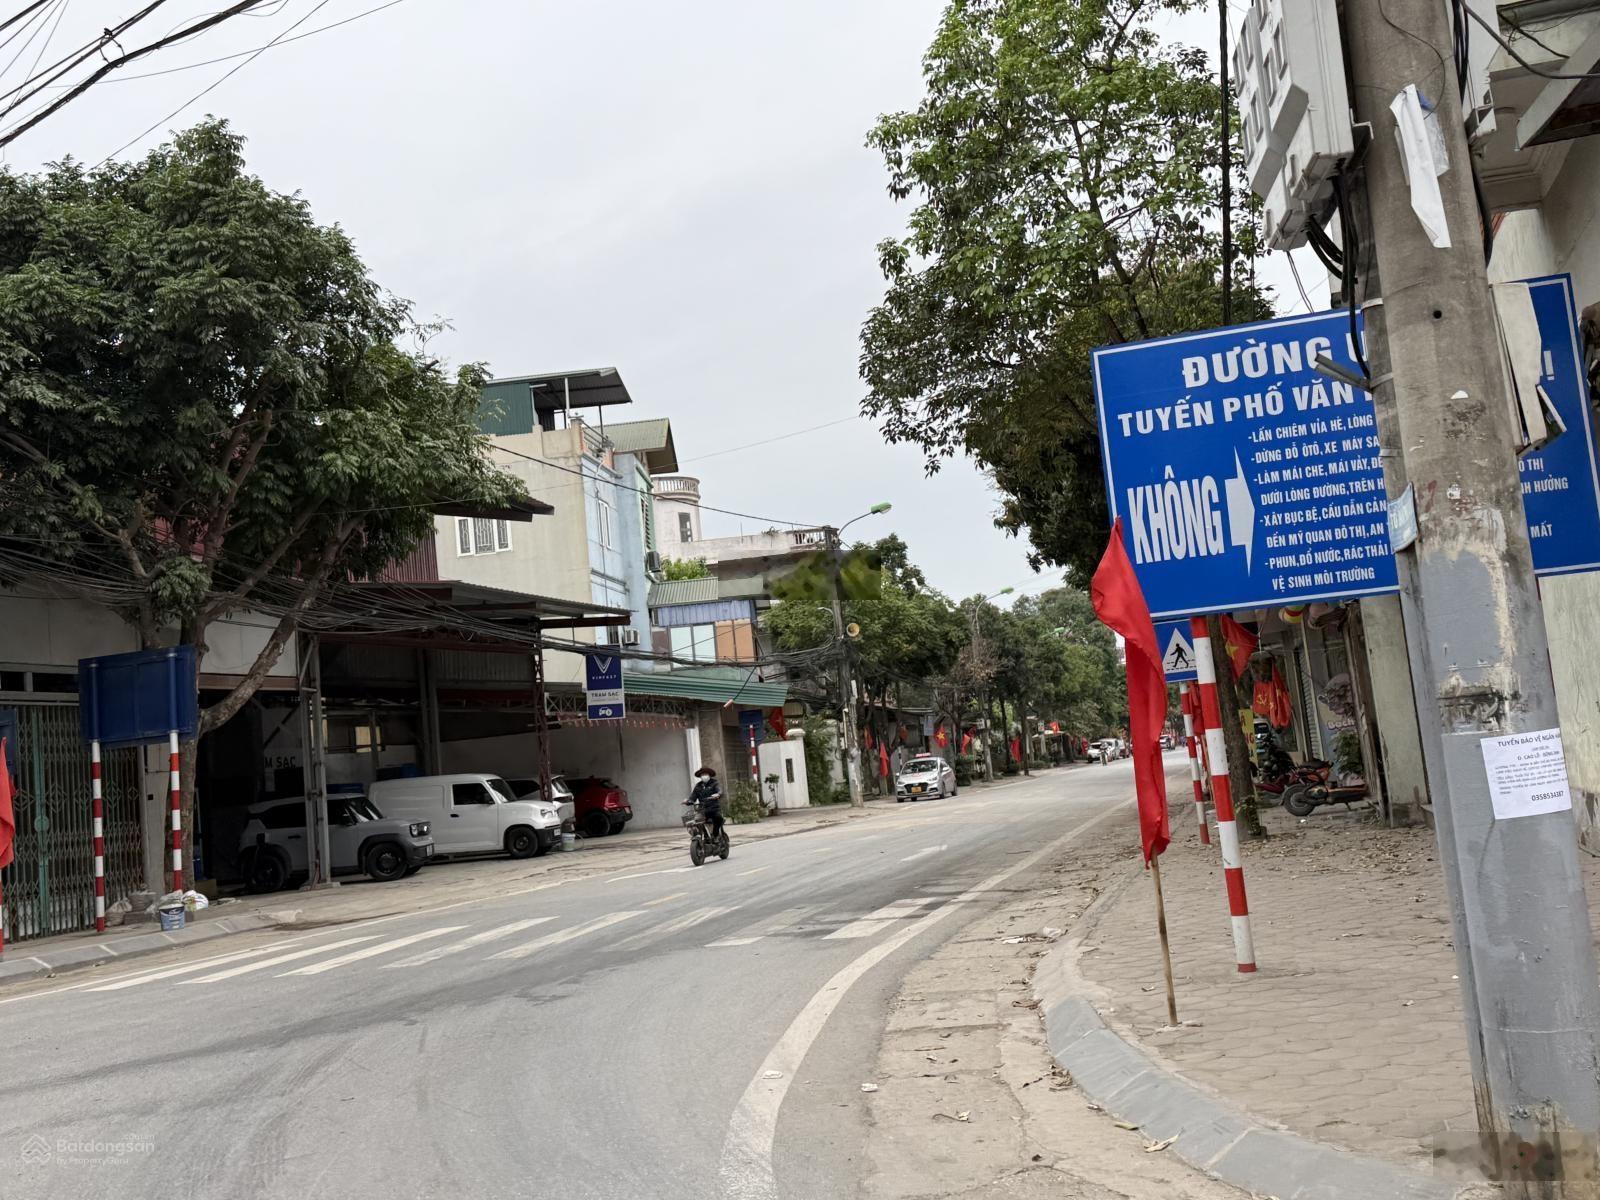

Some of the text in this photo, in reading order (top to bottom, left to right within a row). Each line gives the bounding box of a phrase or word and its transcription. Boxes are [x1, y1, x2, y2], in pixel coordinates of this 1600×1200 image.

[1182, 337, 1332, 388] ĐƯỜNG
[1117, 378, 1354, 437] TUYẾN PHỐ VĂN
[1348, 413, 1373, 429] LÒNG
[1324, 441, 1337, 454] XE
[1342, 435, 1363, 452] MÁY
[1260, 489, 1283, 505] DƯỚI
[1285, 487, 1310, 502] LÒNG
[1349, 477, 1375, 493] TRÊN
[1527, 458, 1544, 472] THỊ
[1282, 466, 1302, 481] MÁI
[1305, 464, 1328, 478] CHE,
[1328, 459, 1348, 475] MÁI
[1127, 465, 1225, 564] KHÔNG
[1284, 510, 1304, 526] BỤC
[1533, 474, 1568, 493] HƯỞNG
[1305, 528, 1332, 544] QUAN
[1335, 525, 1348, 540] ĐÔ
[1371, 522, 1384, 536] AN
[1344, 545, 1363, 560] RÁC
[1530, 520, 1552, 538] MẤT
[1272, 567, 1375, 592] VỆ SINH MÔI TRƯỜNG
